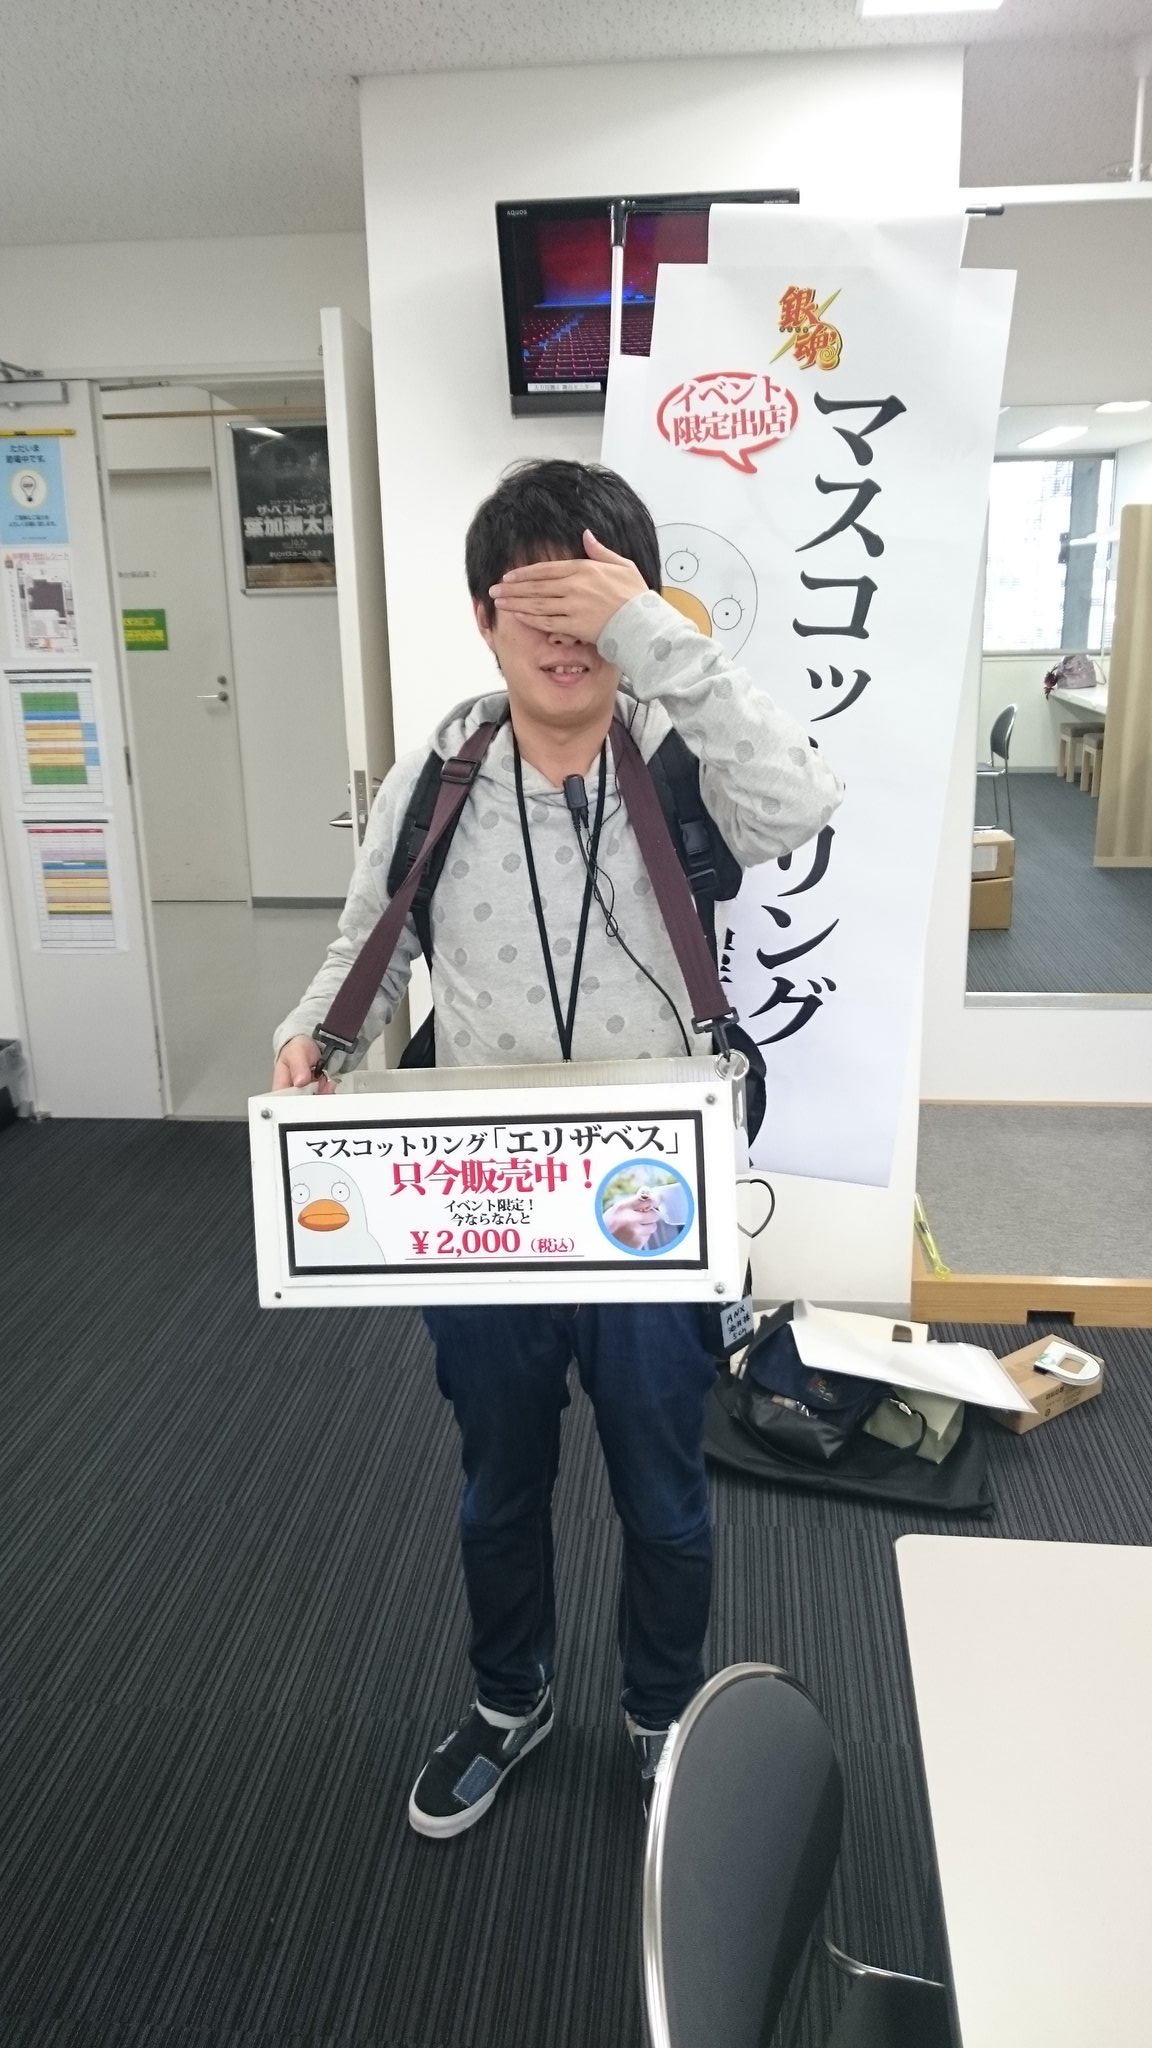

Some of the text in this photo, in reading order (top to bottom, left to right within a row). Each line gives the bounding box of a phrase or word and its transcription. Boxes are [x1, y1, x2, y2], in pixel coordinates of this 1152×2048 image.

[506, 209, 528, 217] AQUOS
[778, 284, 843, 371] 銀魂
[672, 375, 782, 413] イベント
[672, 404, 788, 447] 限定出店
[748, 391, 908, 1046] マスコッリング
[305, 1123, 679, 1159] マスコットリング「エリザベス」
[390, 1156, 593, 1196] 只今販売中！
[444, 1199, 534, 1213] イベント限定！
[450, 1211, 532, 1226] 今ならなんと
